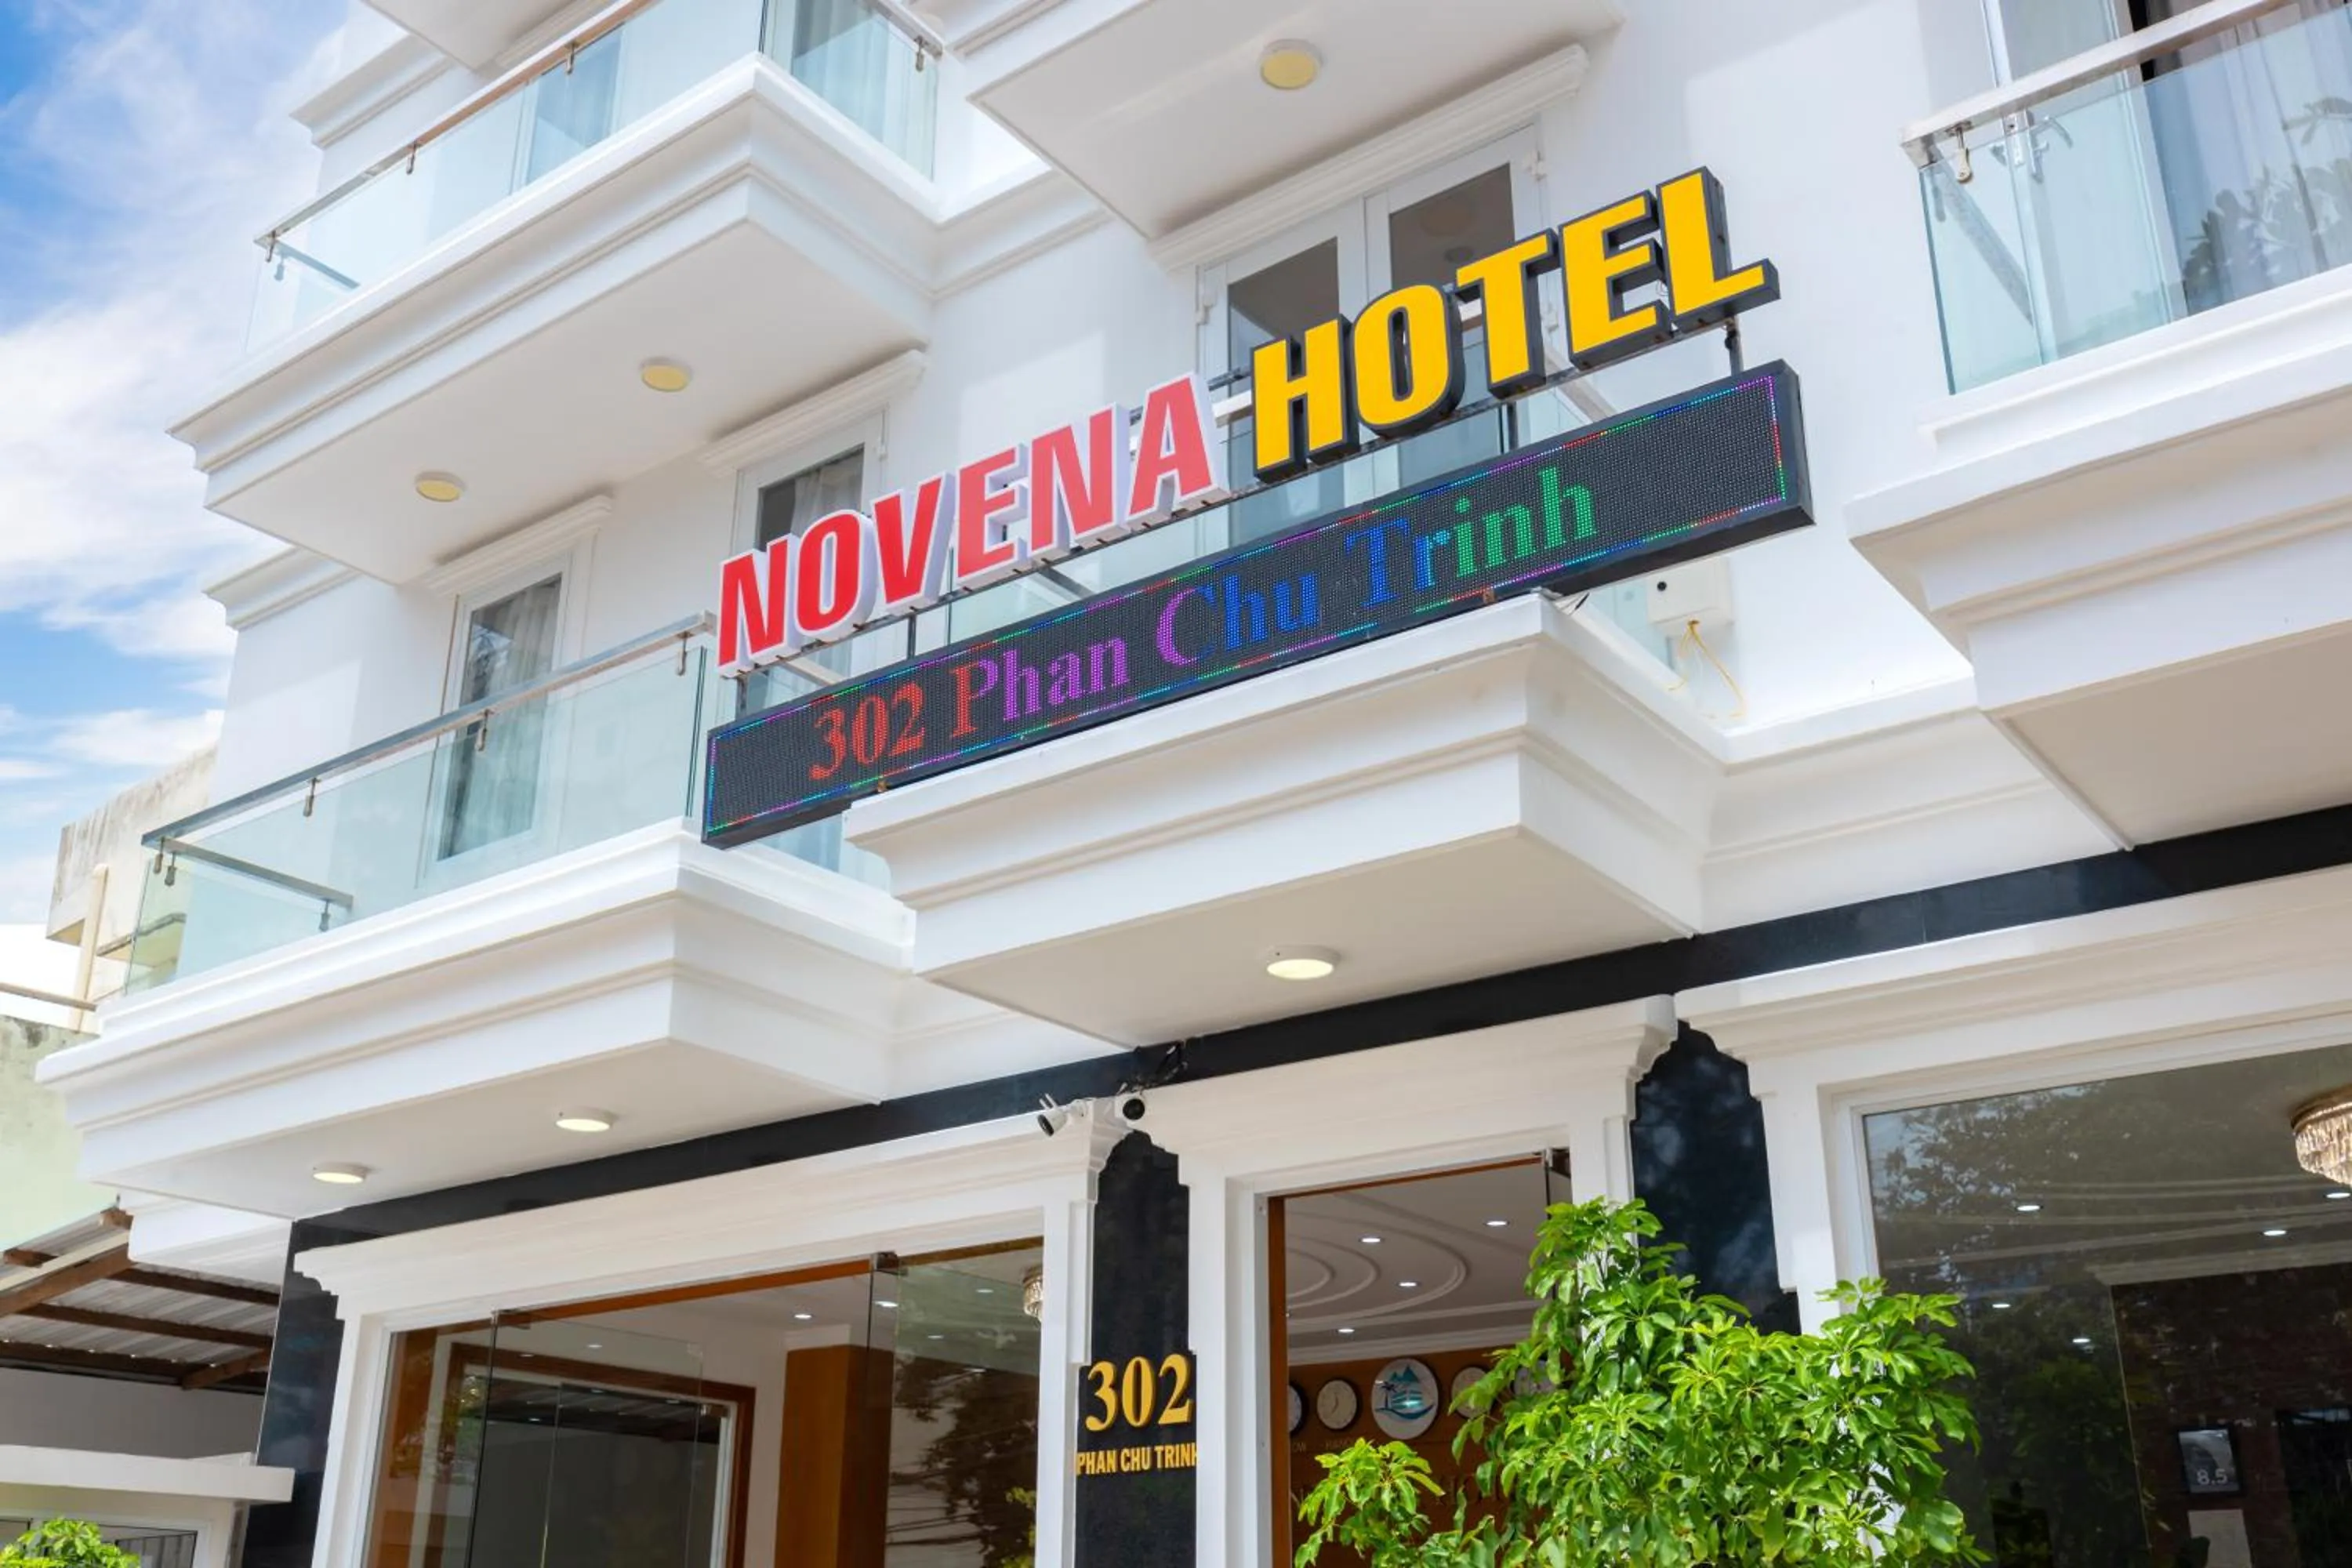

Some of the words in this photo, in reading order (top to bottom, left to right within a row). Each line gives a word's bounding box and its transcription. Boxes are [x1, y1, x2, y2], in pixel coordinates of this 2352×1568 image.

[717, 372, 1225, 679] NOVENA
[1252, 168, 1773, 480] HOTEL
[808, 681, 926, 780] 302
[949, 634, 1131, 739] Phan
[1156, 572, 1320, 666] Chu
[1344, 466, 1597, 608] Trinh
[1085, 1353, 1194, 1432] 302
[1075, 1450, 1117, 1476] PHAN
[1120, 1446, 1152, 1472] CHU
[2197, 1468, 2228, 1485] 8.5
